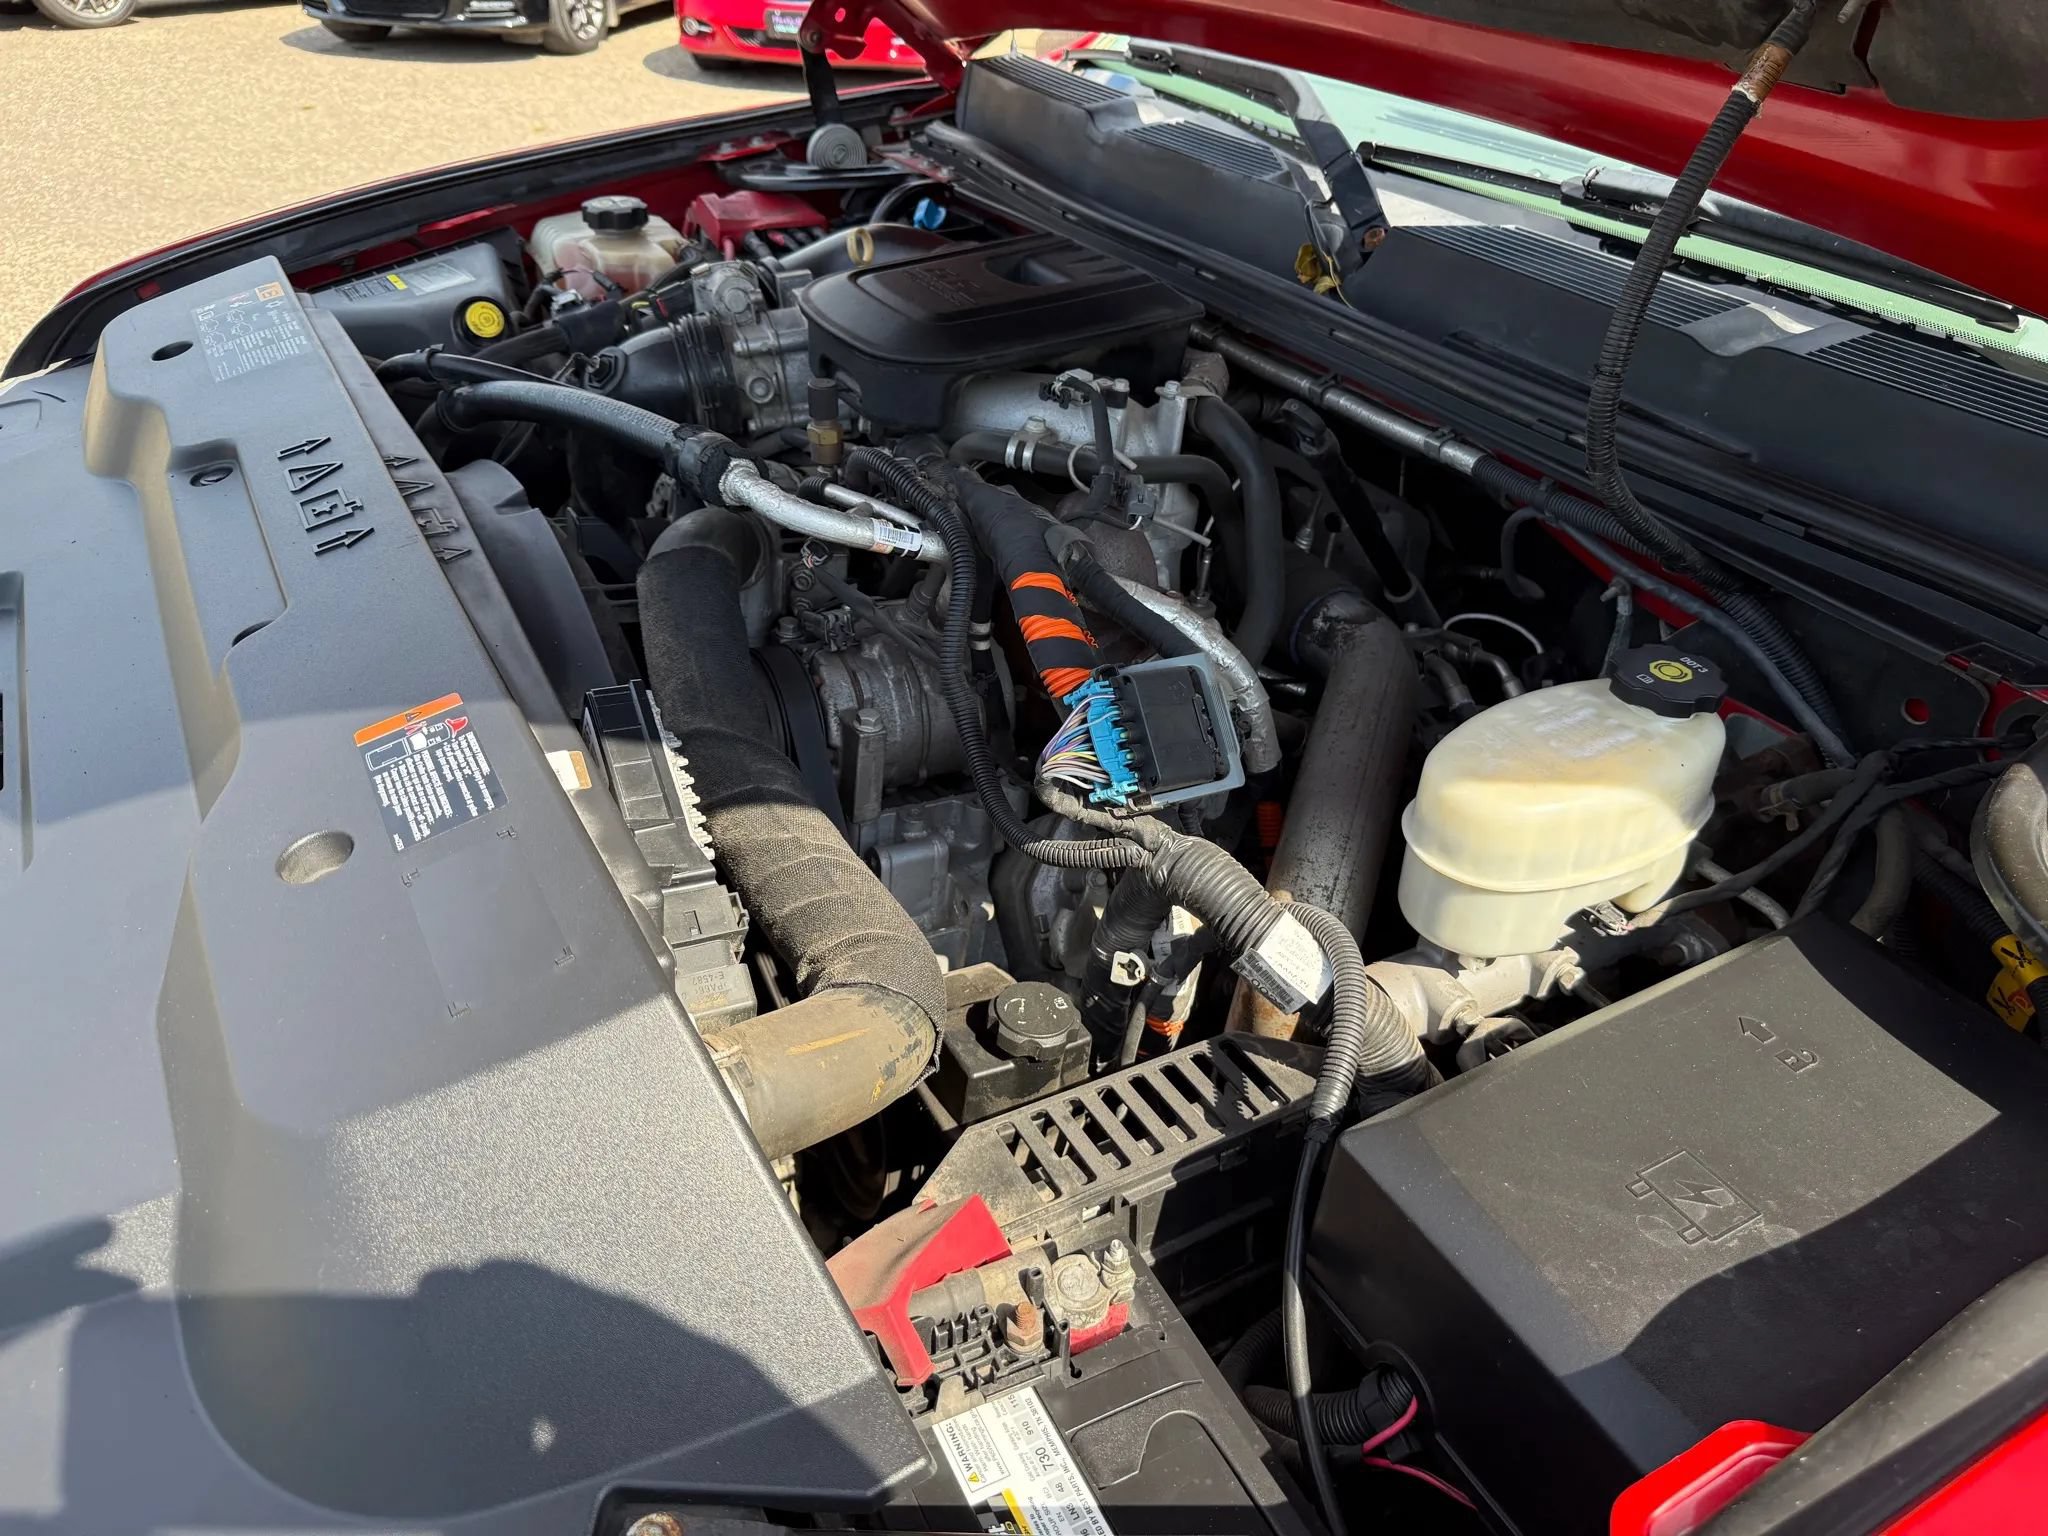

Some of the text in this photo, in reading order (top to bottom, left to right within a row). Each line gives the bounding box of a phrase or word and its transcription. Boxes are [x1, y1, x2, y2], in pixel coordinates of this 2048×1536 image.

[1680, 657, 1702, 669] DOT
[1006, 1392, 1020, 1409] 115
[1020, 1419, 1034, 1436] 910
[1034, 1415, 1044, 1426] TN
[943, 1421, 973, 1472] WARNING:
[1032, 1444, 1056, 1472] 730
[1054, 1480, 1066, 1494] 48
[1064, 1501, 1081, 1521] LN3
[1078, 1496, 1094, 1516] BEST
[1054, 1510, 1065, 1523] EN
[1087, 1513, 1099, 1526] BY
